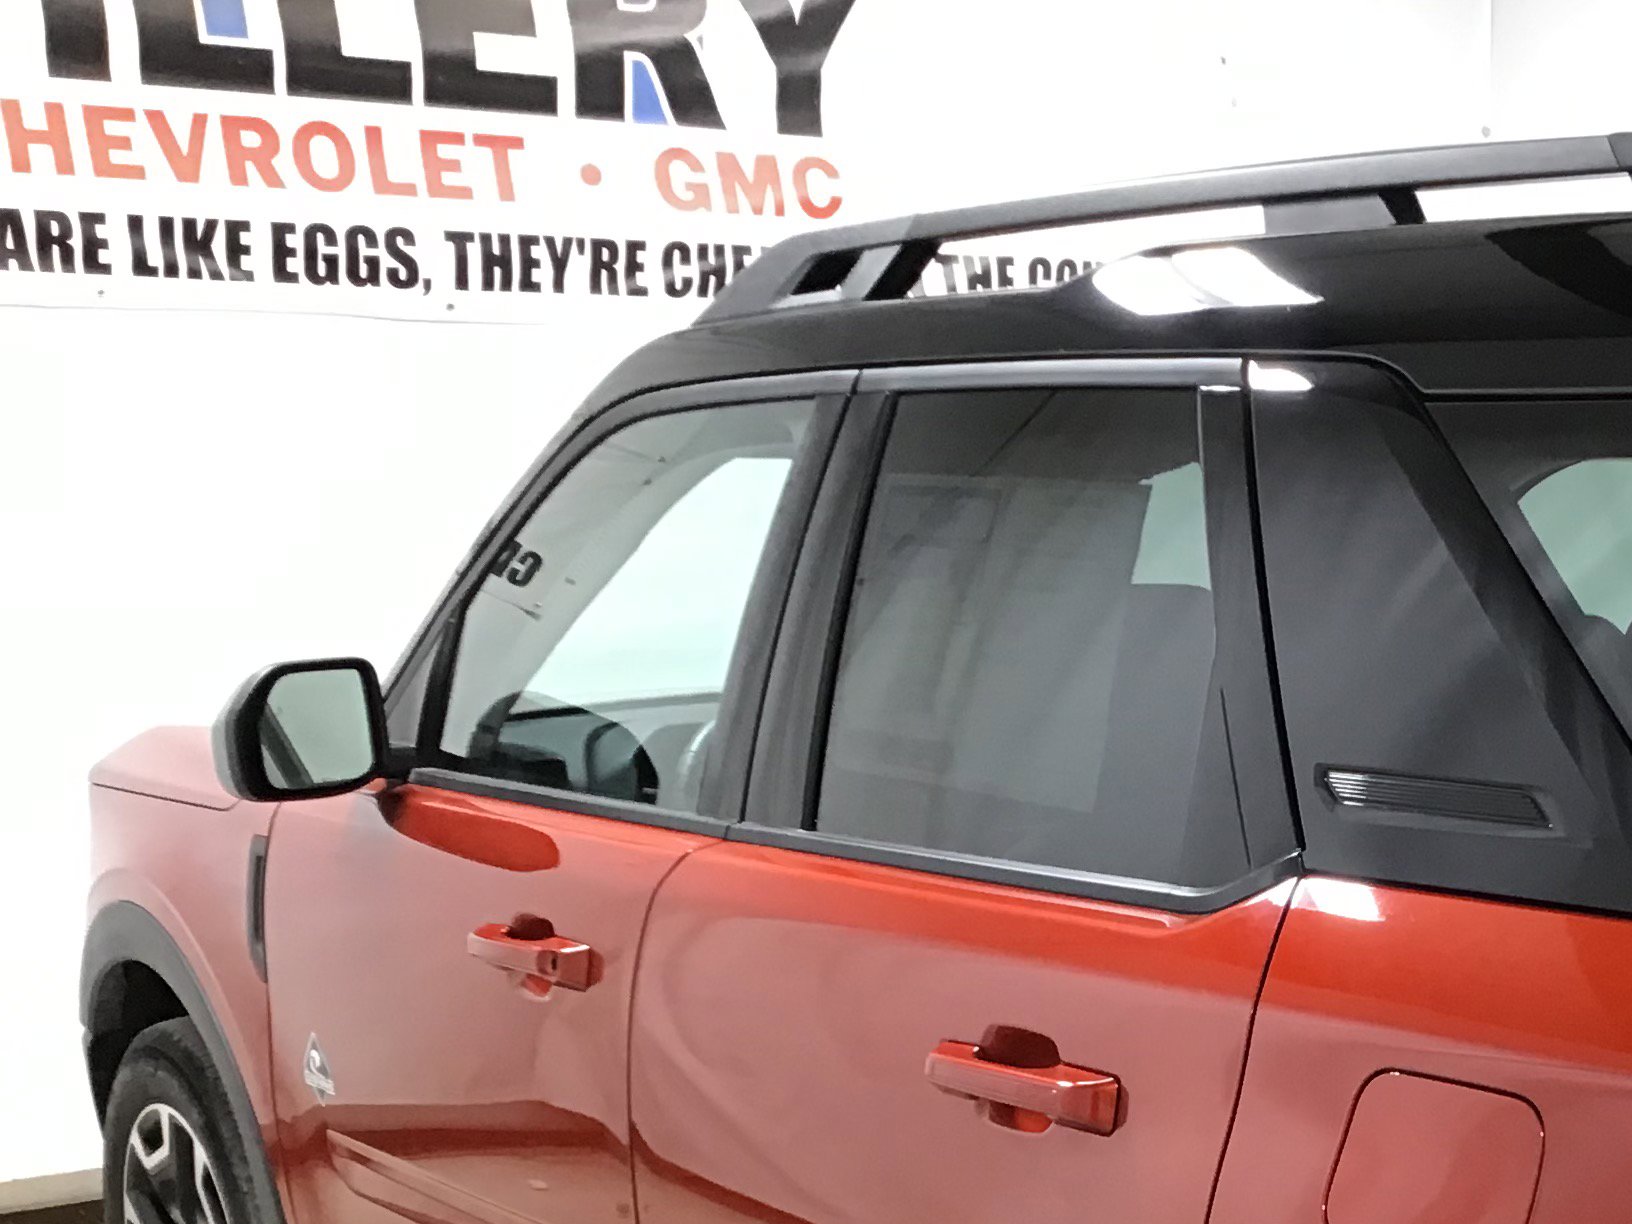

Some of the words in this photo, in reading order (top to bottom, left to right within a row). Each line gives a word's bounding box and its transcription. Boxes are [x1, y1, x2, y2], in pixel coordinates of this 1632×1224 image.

[0, 99, 524, 202] HEVROLET
[654, 147, 843, 219] GMC
[0, 208, 113, 275] ARE
[127, 214, 255, 282] LIKE
[271, 222, 432, 296] EGGS,
[444, 230, 649, 296] THEY'RE
